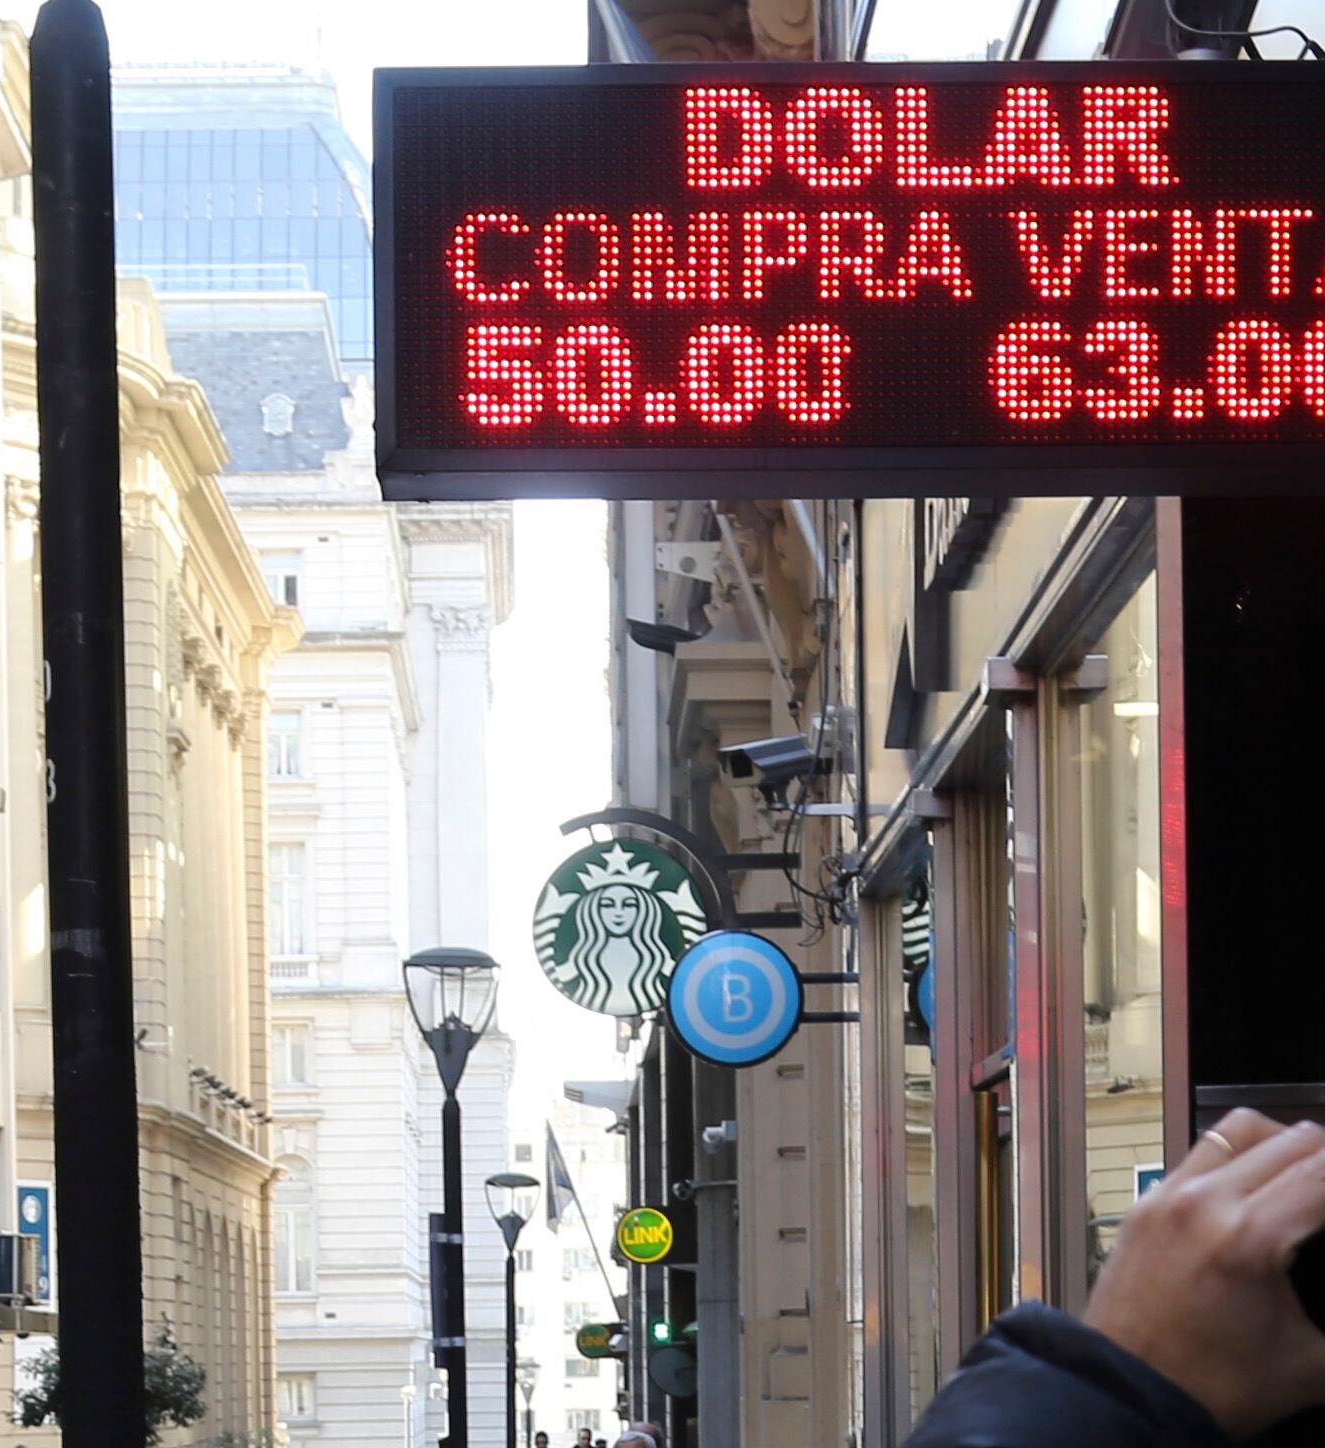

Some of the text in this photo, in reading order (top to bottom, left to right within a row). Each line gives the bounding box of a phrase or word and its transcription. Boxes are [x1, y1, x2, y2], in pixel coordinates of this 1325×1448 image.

[684, 86, 1180, 189] DOLAR
[446, 210, 974, 303] COMPRA
[460, 322, 852, 427] 50.00
[723, 973, 754, 1022] B
[625, 1220, 669, 1245] LINK
